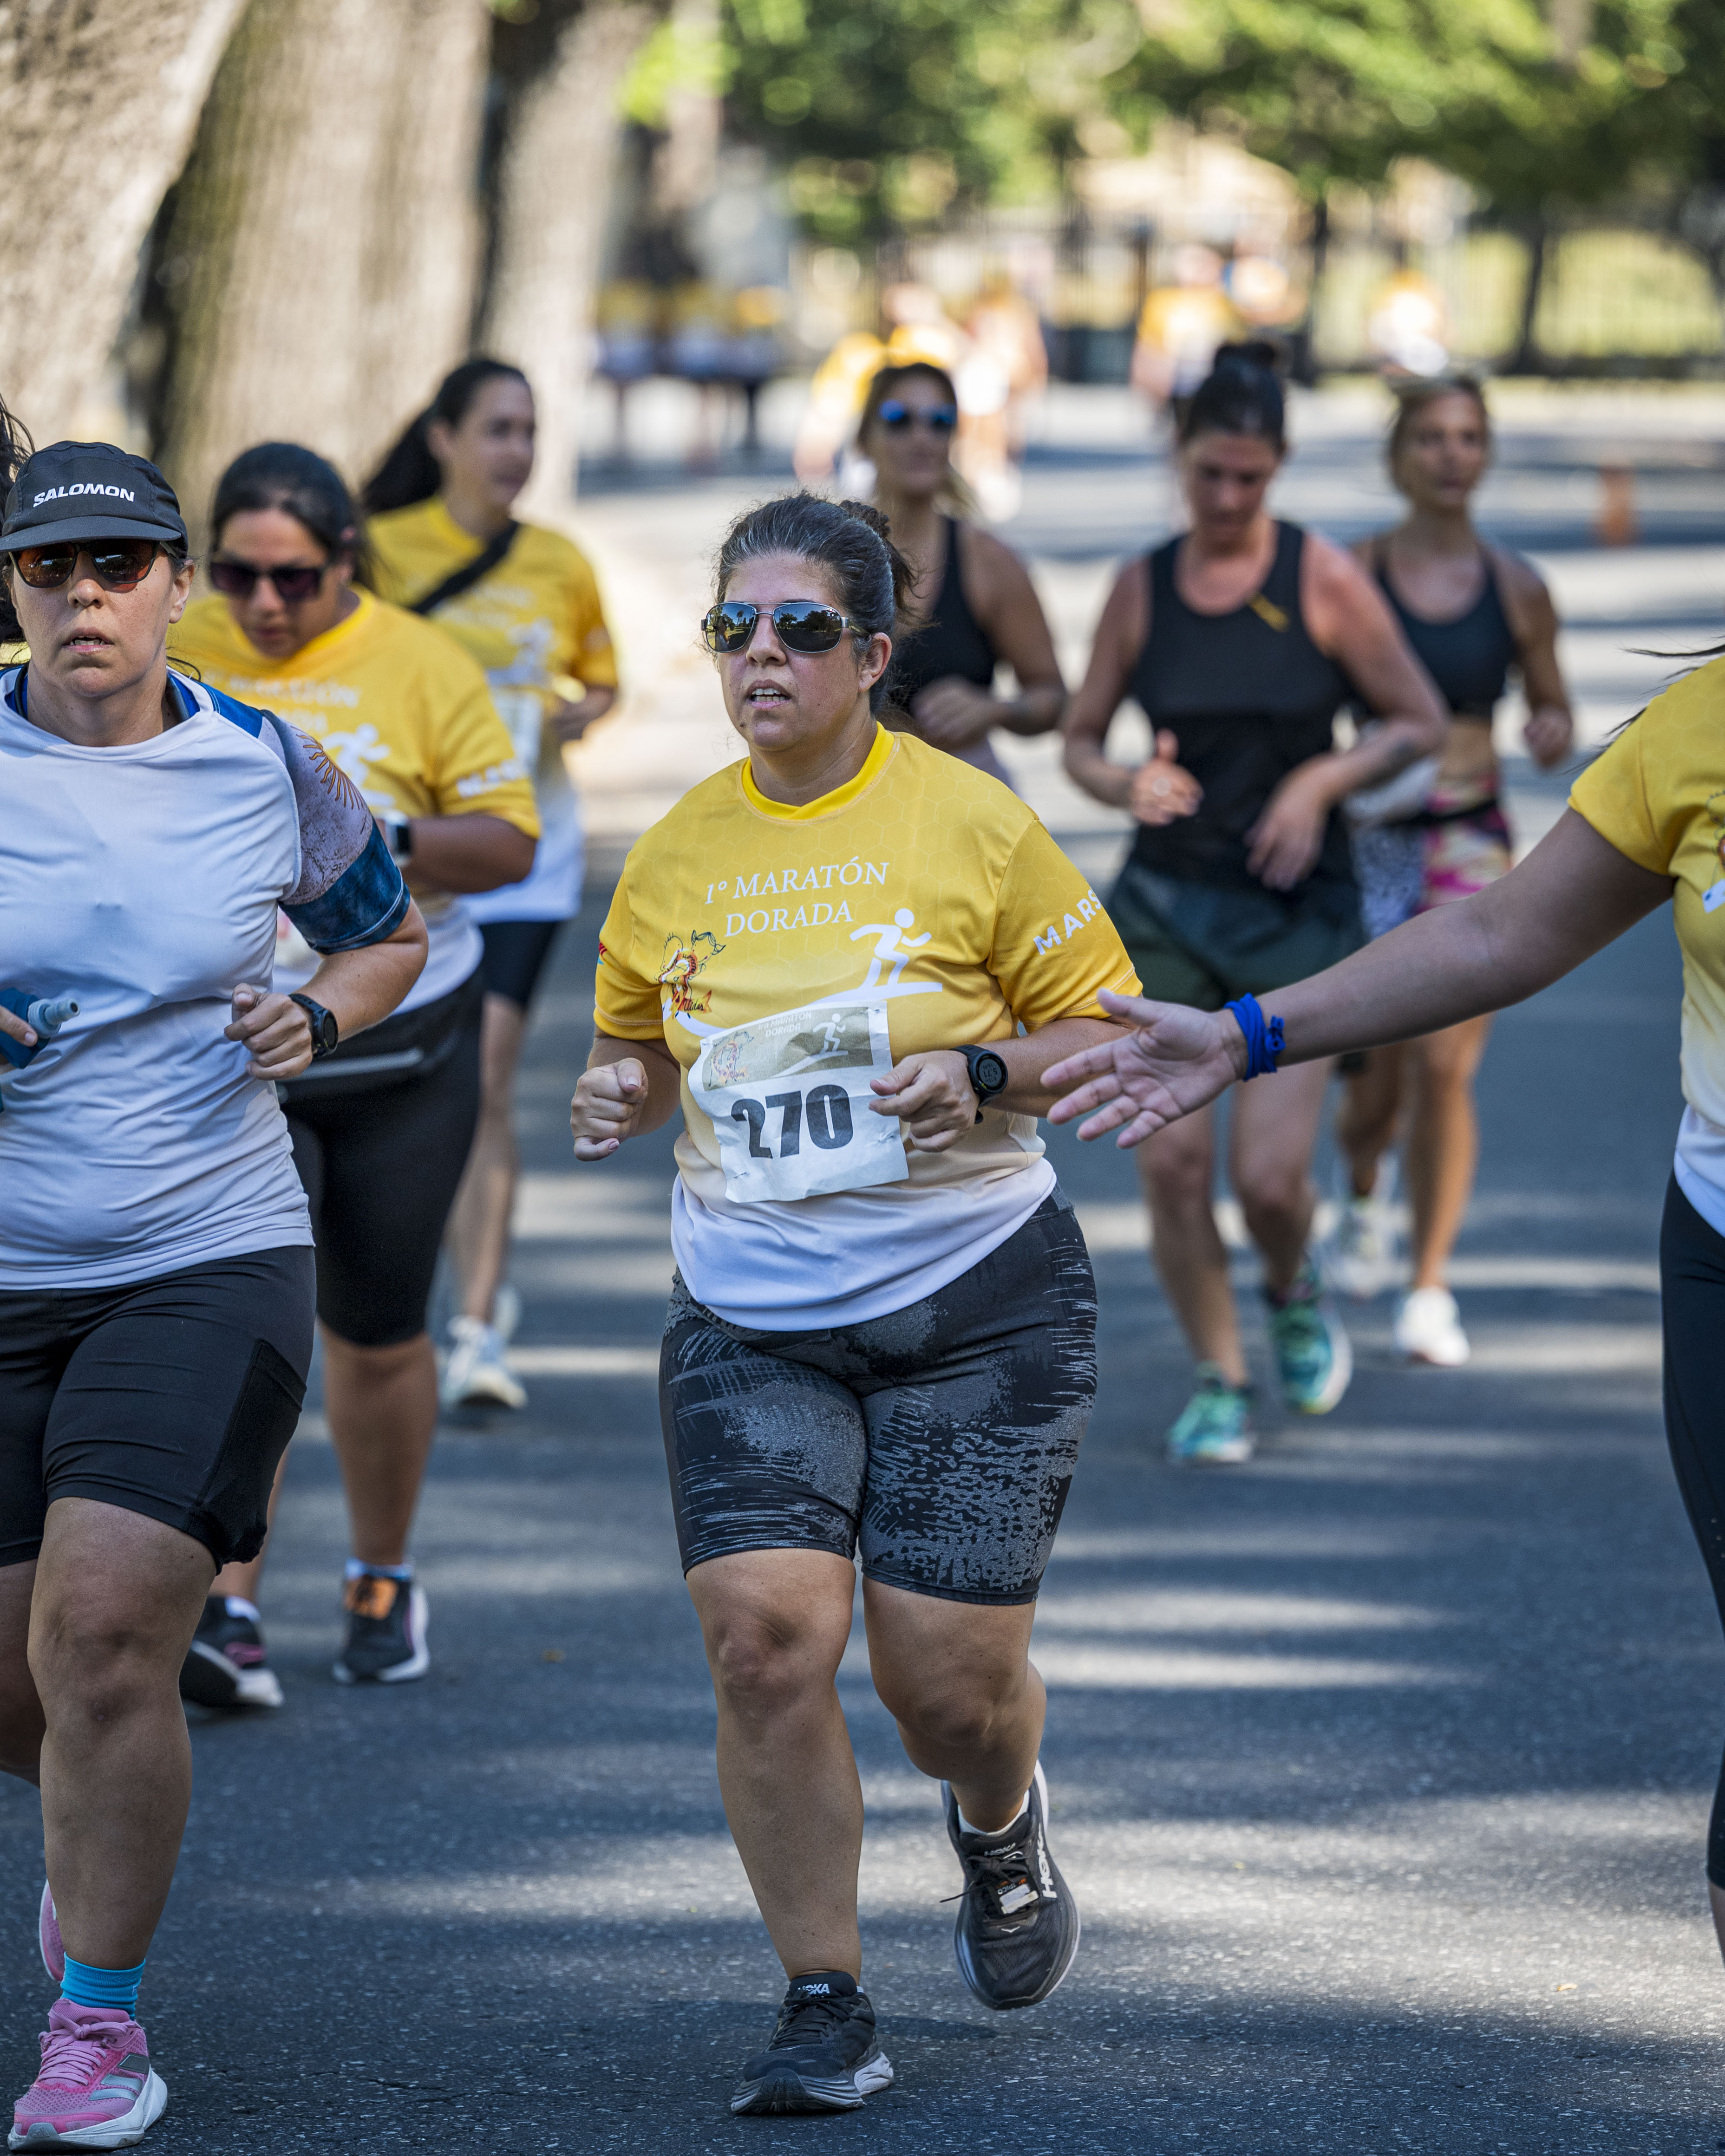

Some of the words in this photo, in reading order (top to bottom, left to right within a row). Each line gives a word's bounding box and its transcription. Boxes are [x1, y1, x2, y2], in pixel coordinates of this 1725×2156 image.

[33, 483, 135, 508] SALOMON
[732, 856, 890, 899] MARATÓN
[725, 900, 854, 937] DORADA
[765, 1023, 801, 1038] DORADA
[731, 1084, 853, 1159] 270
[798, 1983, 830, 1995] OKA
